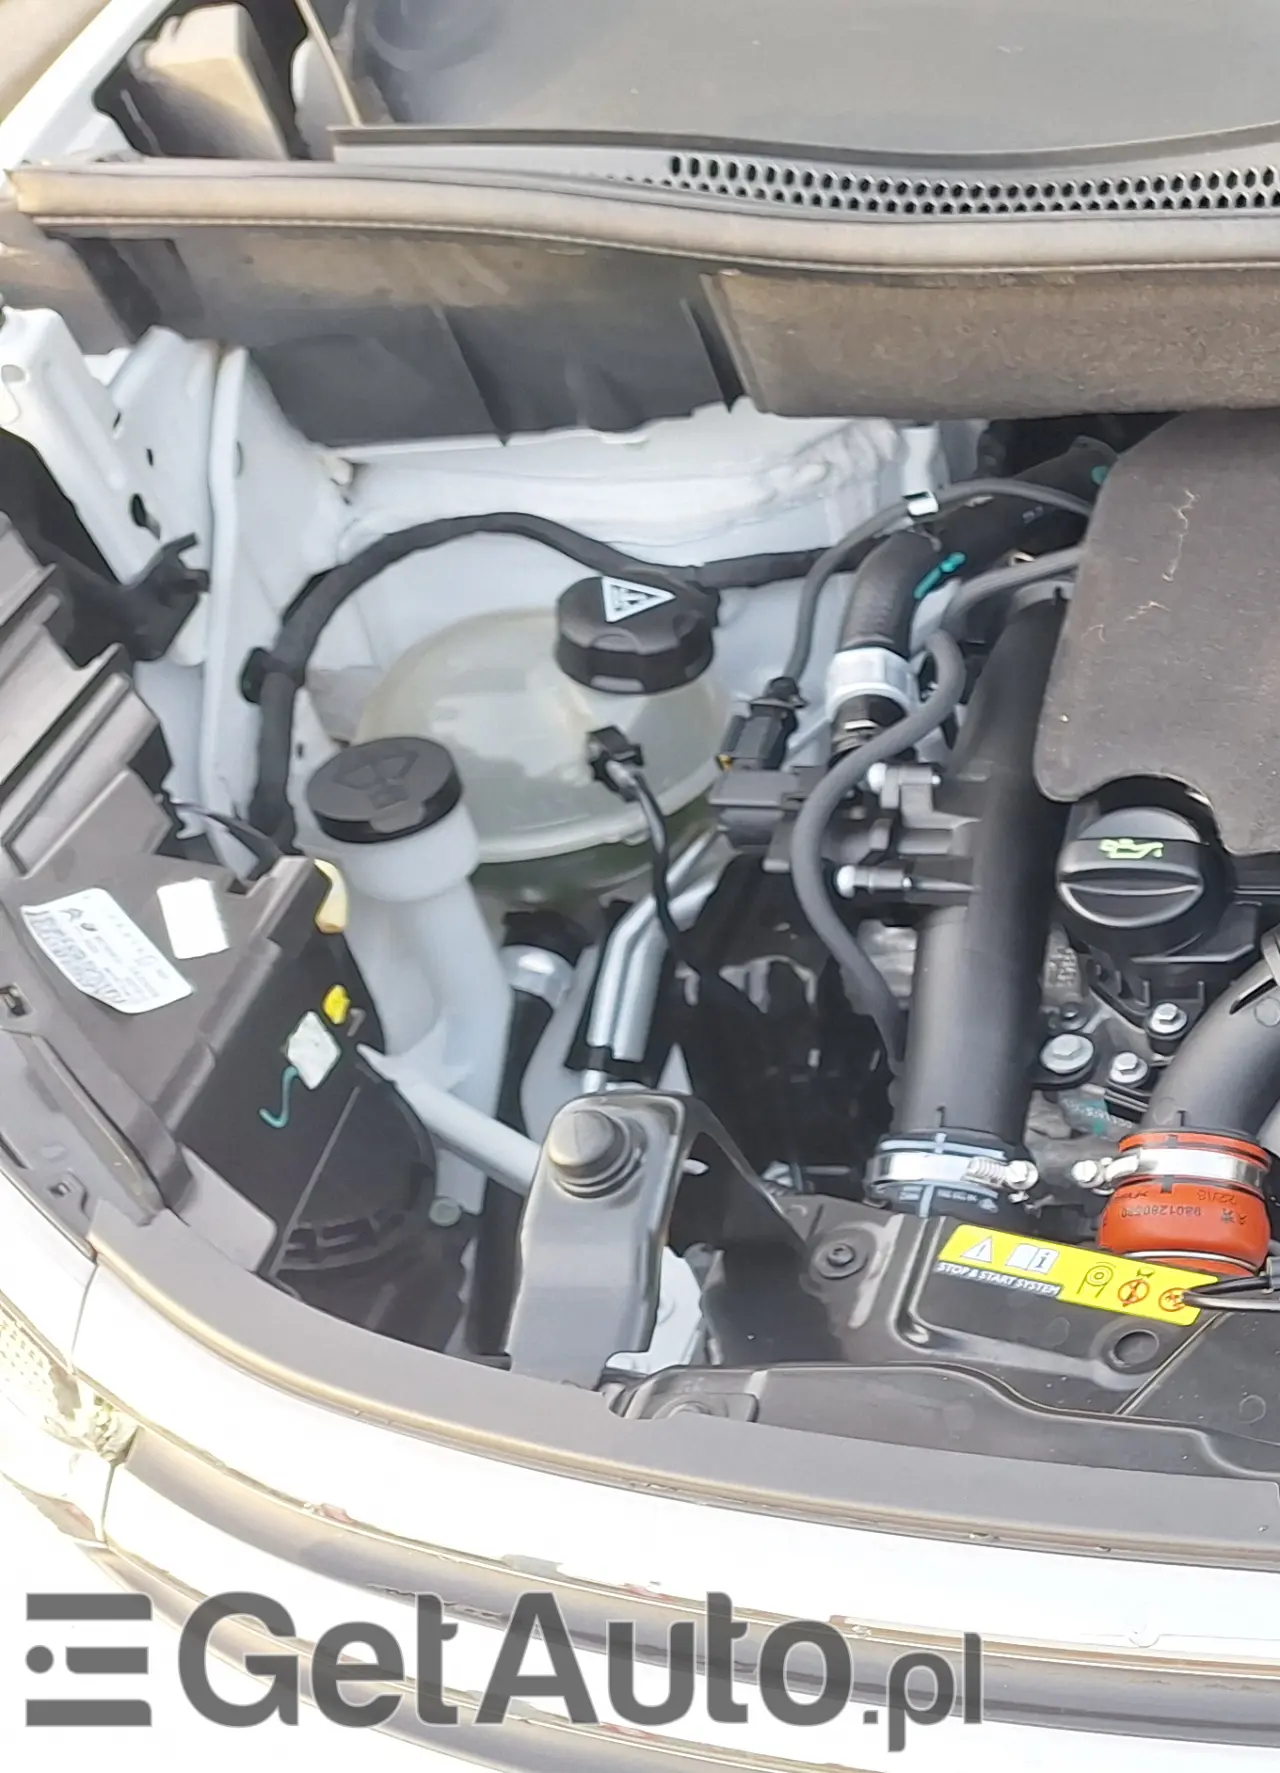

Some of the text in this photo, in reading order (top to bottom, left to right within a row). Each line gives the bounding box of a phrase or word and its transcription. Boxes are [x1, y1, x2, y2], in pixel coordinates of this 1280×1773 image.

[937, 1260, 970, 1276] STOP
[978, 1269, 1018, 1286] START
[1015, 1277, 1062, 1296] SYSTEM
